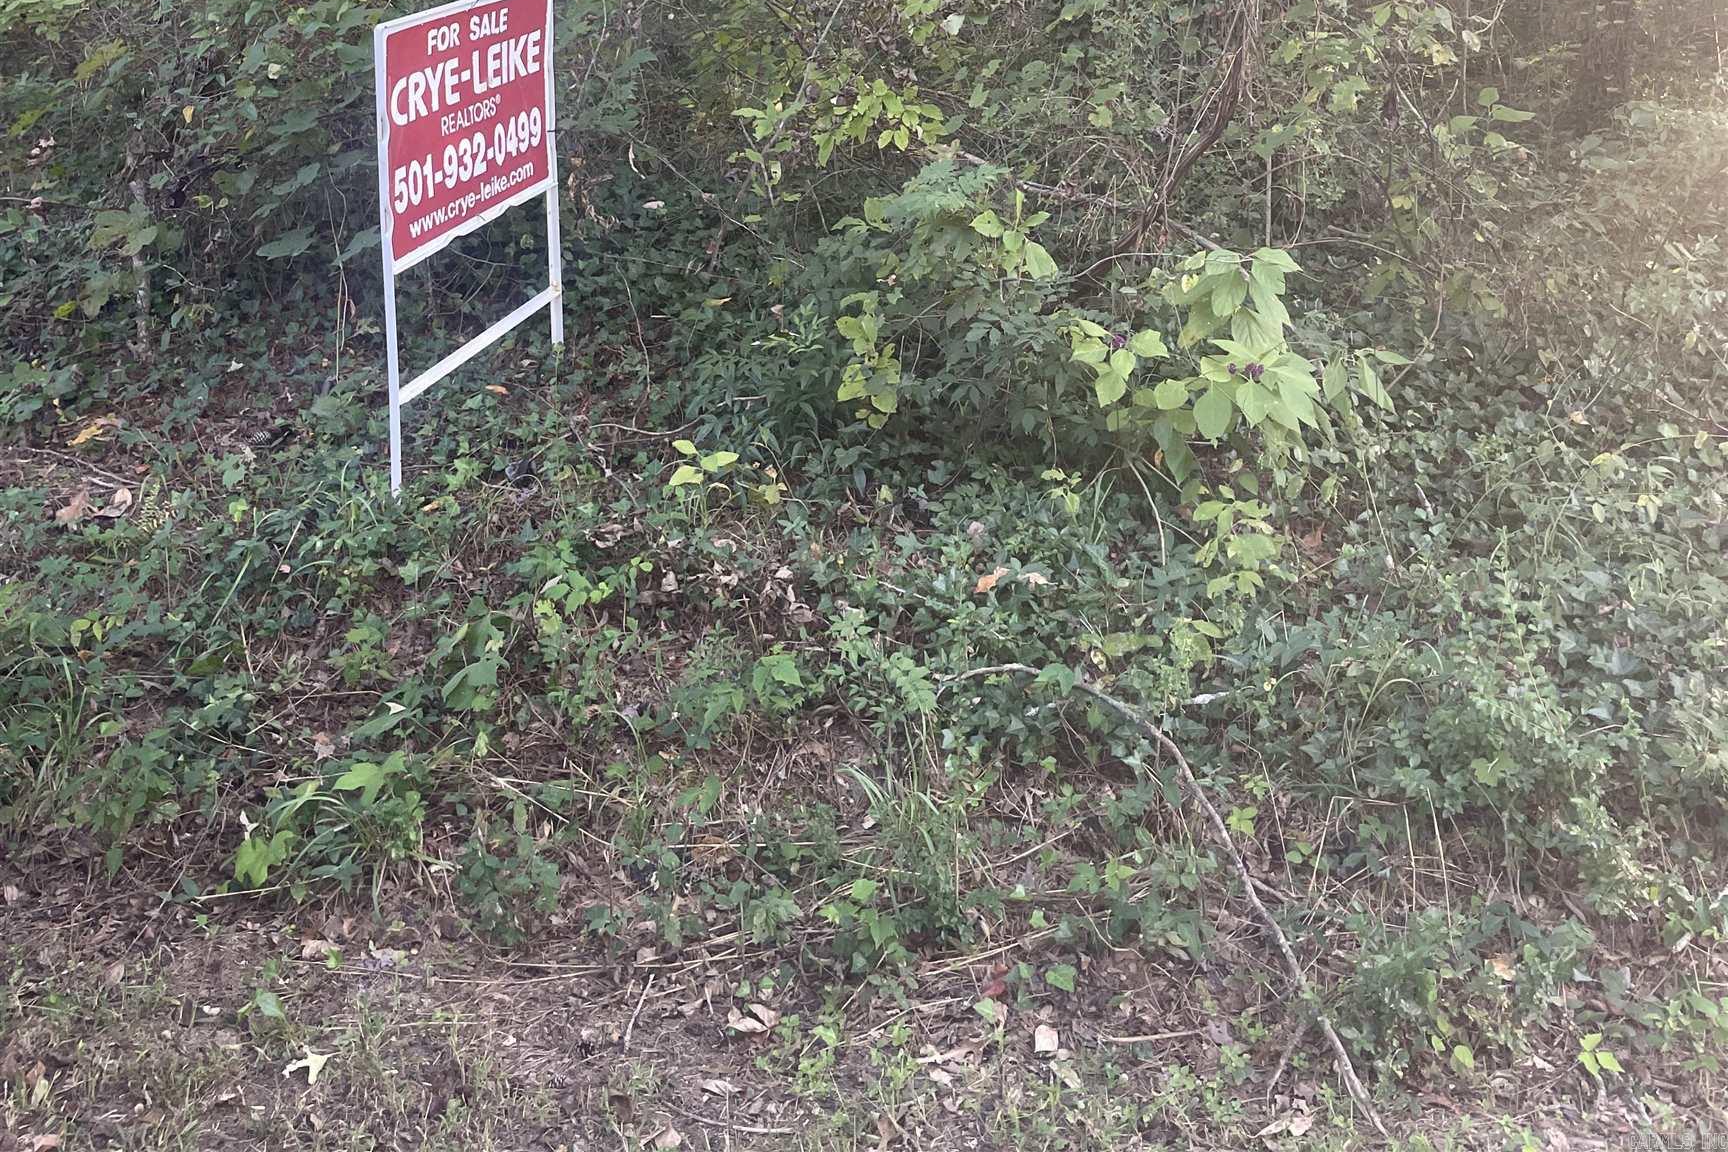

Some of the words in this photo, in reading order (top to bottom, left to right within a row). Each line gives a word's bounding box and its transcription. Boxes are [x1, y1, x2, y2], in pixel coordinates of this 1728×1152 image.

[427, 24, 460, 55] FOR
[469, 8, 508, 40] SALE
[390, 29, 541, 126] CRYE-LEIKE
[394, 106, 542, 214] 501-932-0499
[409, 160, 534, 238] www.crye-leike.com
